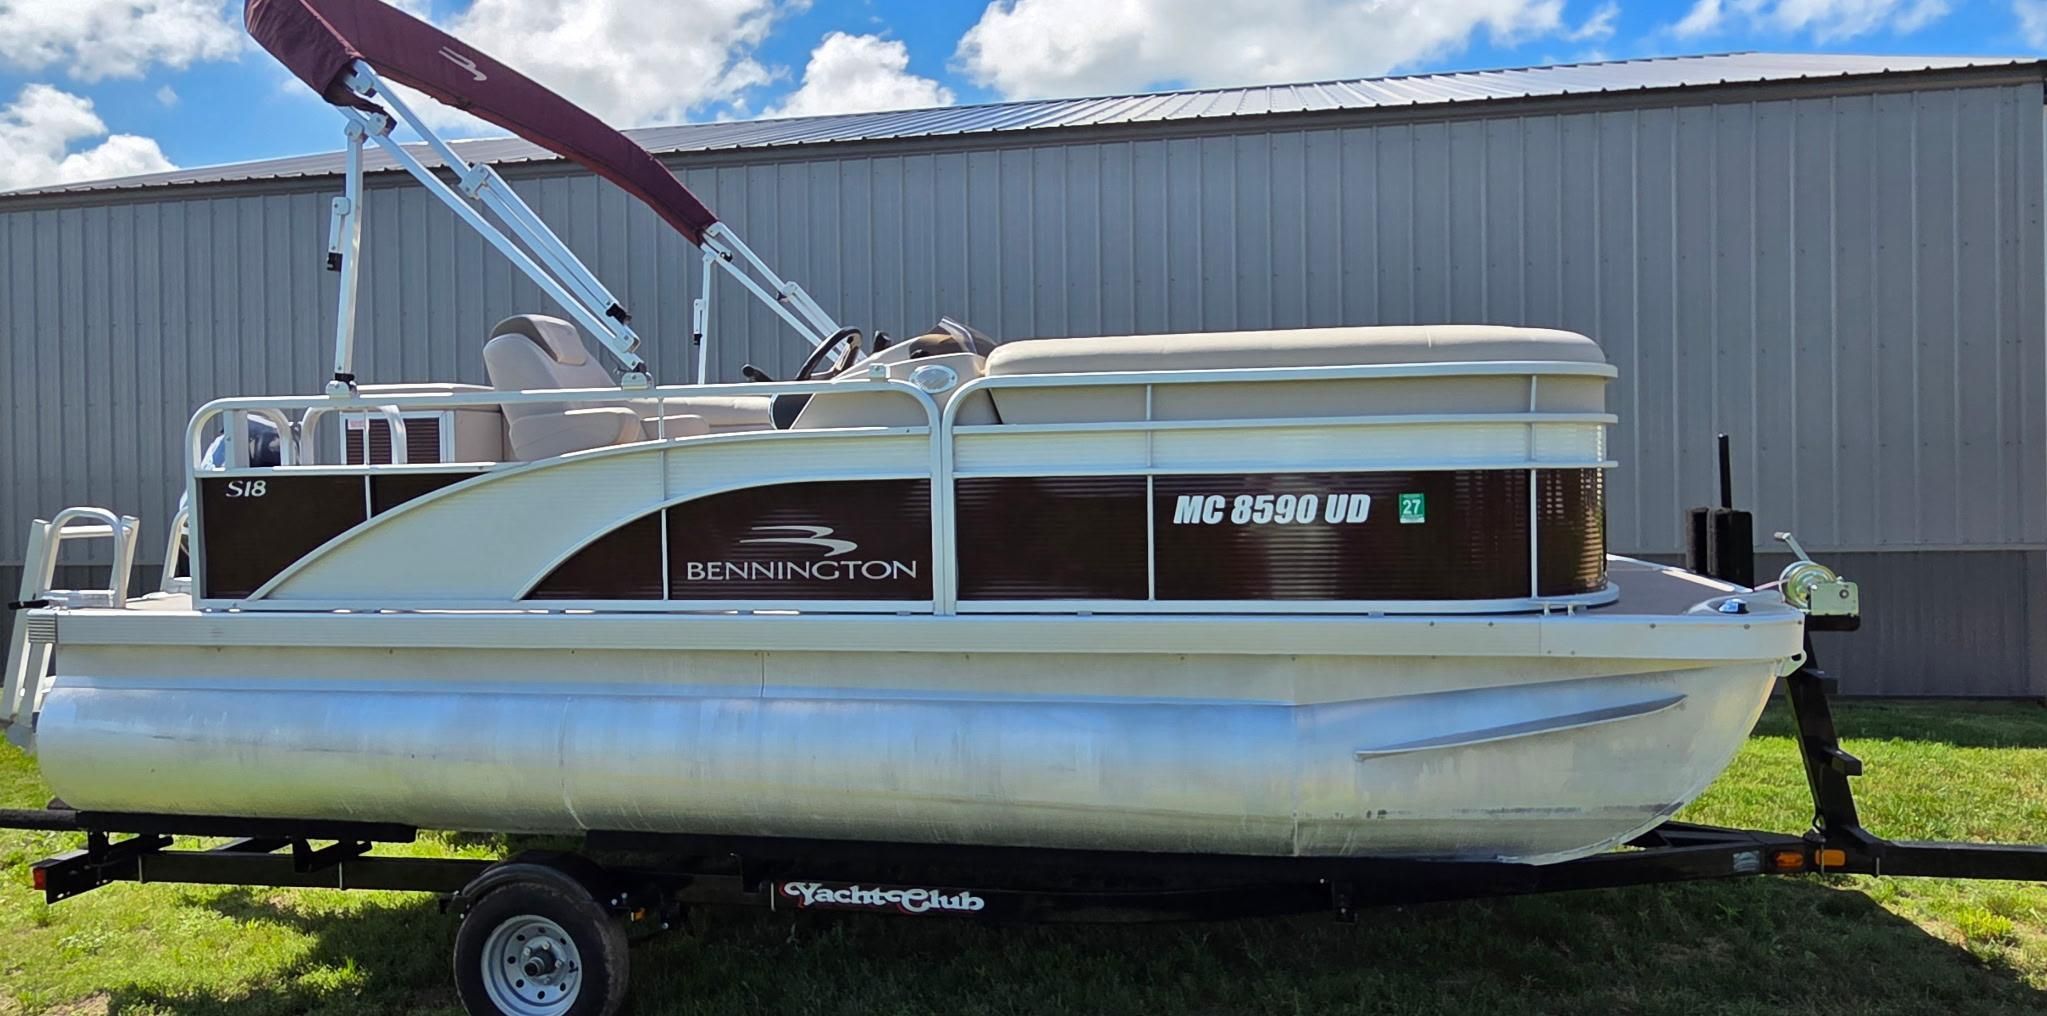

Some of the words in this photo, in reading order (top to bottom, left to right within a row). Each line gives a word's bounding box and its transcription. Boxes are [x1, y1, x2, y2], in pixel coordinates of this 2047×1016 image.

[225, 480, 266, 497] S18
[1173, 494, 1226, 525] MC
[1231, 494, 1320, 525] 8590
[1324, 493, 1371, 524] UD
[1402, 499, 1421, 514] 27
[687, 560, 917, 580] BENNINGTON
